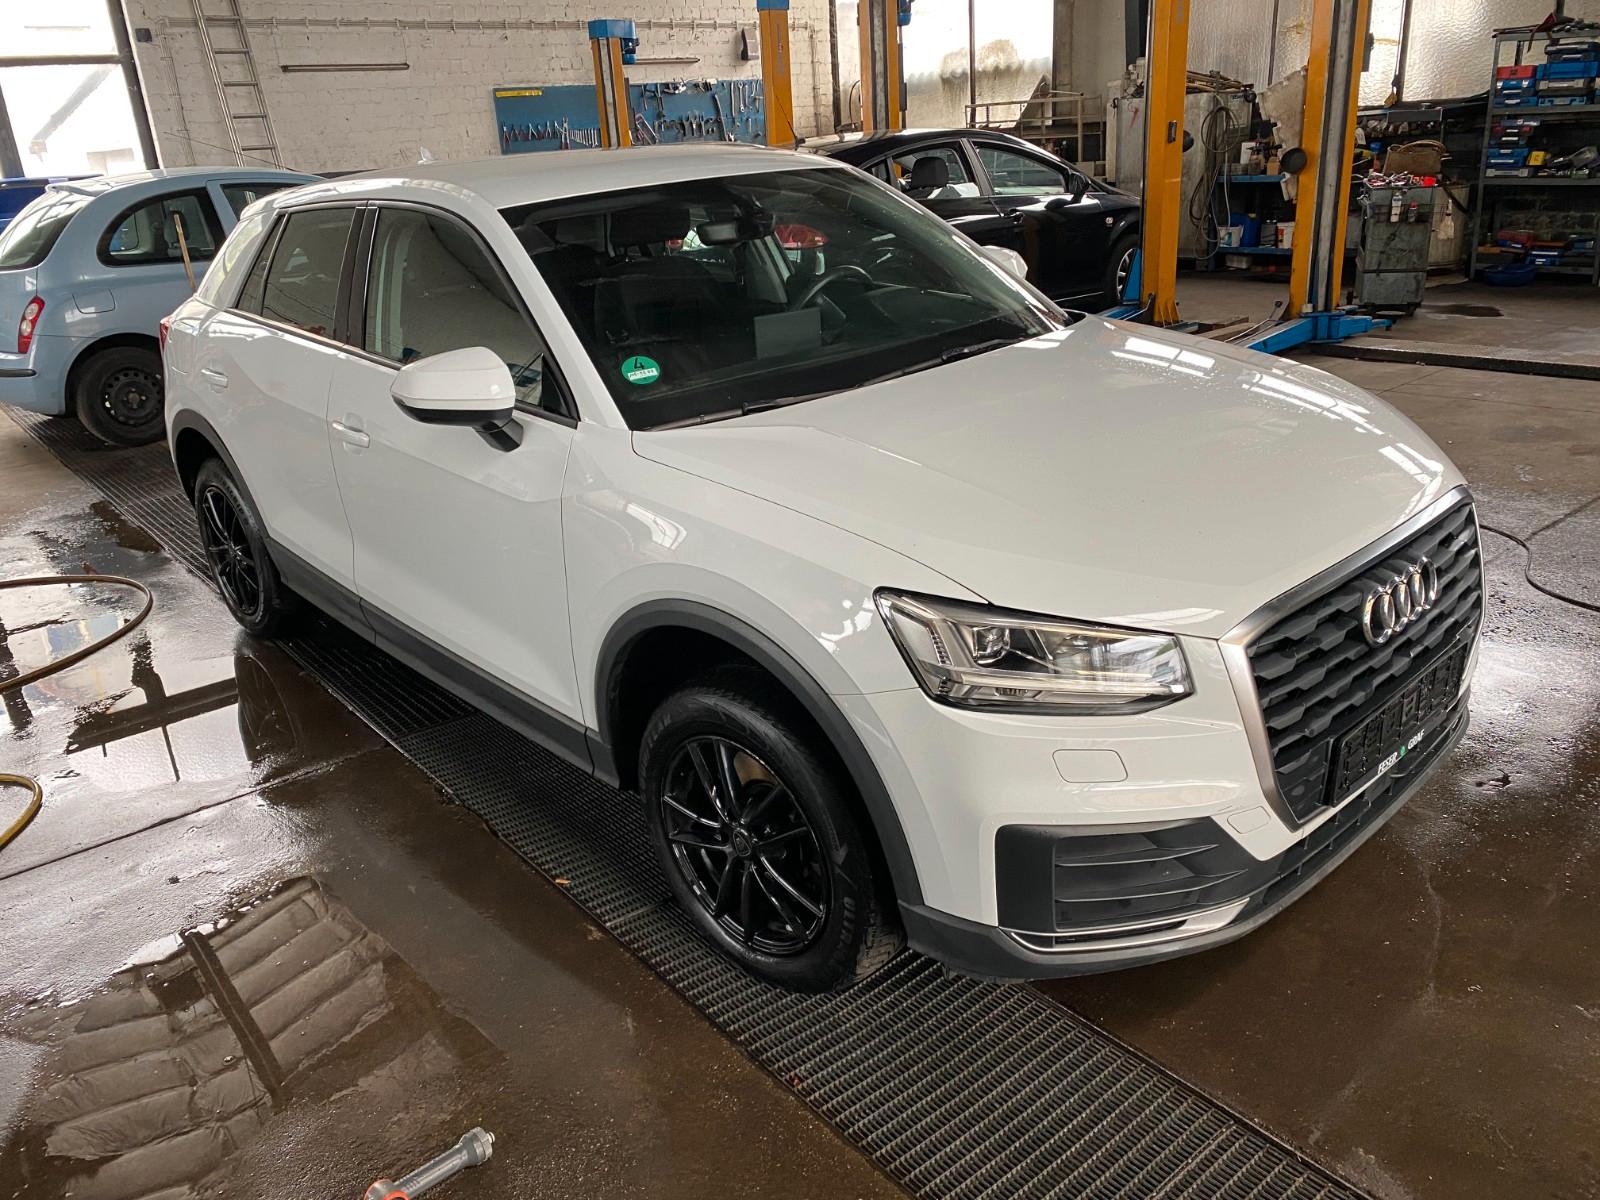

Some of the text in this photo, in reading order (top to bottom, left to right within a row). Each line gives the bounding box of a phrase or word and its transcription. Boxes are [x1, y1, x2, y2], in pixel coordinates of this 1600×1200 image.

[633, 357, 645, 369] 4
[1377, 728, 1425, 774] FESER GRAF
